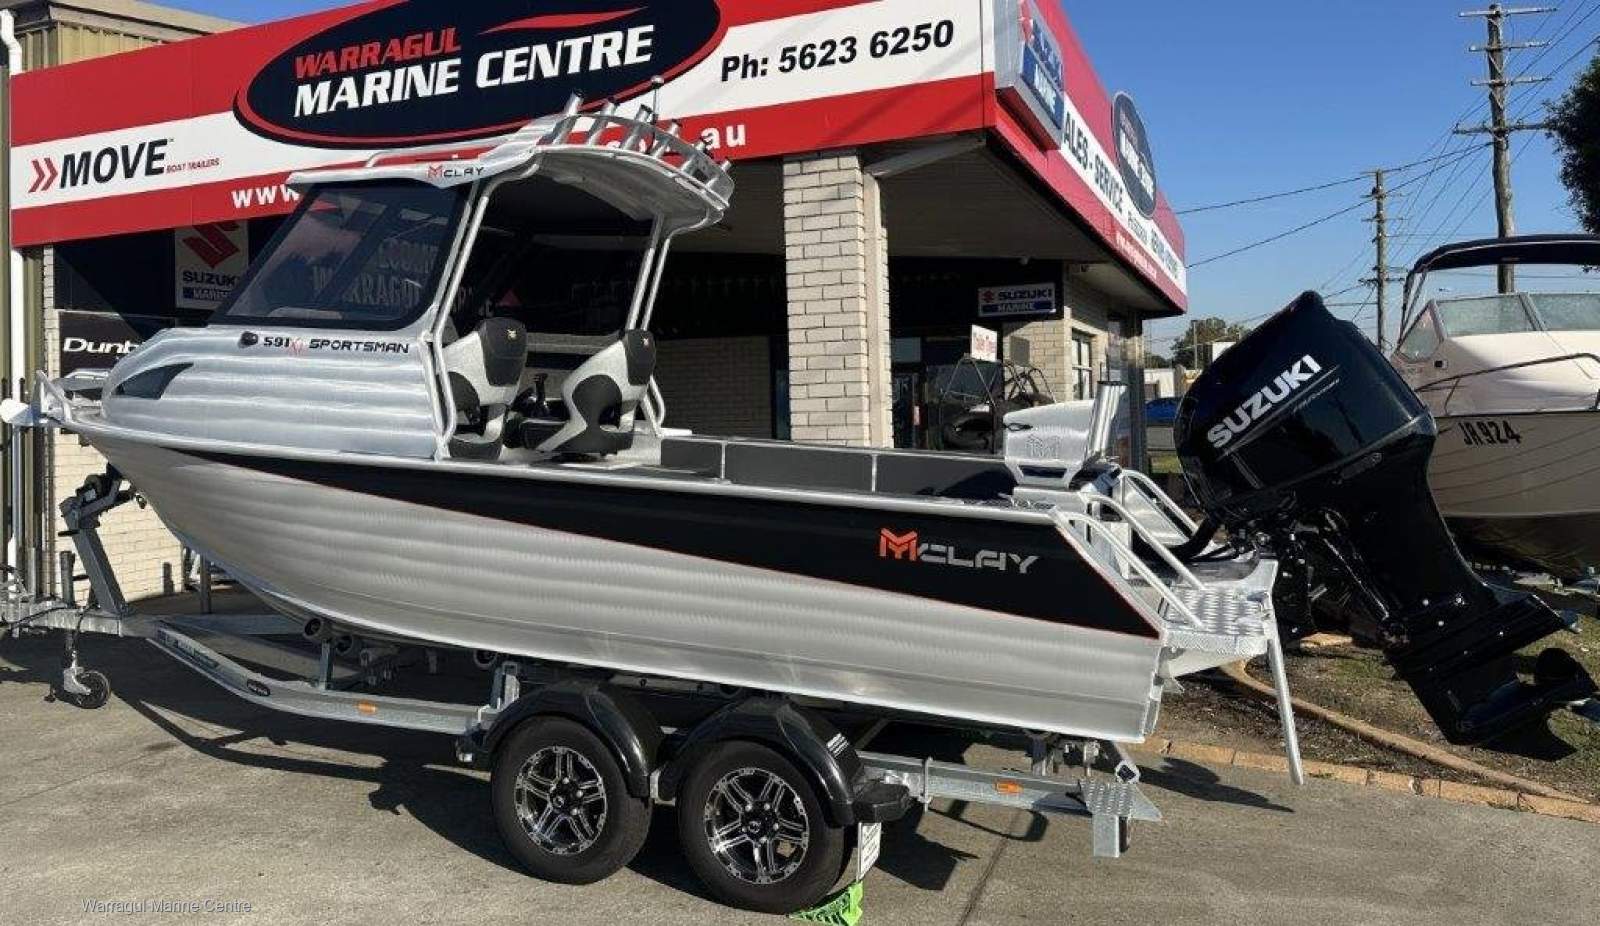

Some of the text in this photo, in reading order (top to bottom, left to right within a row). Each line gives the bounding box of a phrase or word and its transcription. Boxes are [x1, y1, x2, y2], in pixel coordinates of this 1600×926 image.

[294, 27, 462, 79] WARRAGUL
[294, 25, 654, 118] MARINE CENTRE
[721, 19, 954, 82] Ph: 5623 6250
[60, 138, 168, 189] MOVE
[309, 338, 409, 354] SPORTSMAN
[1207, 354, 1322, 448] SUZUKI
